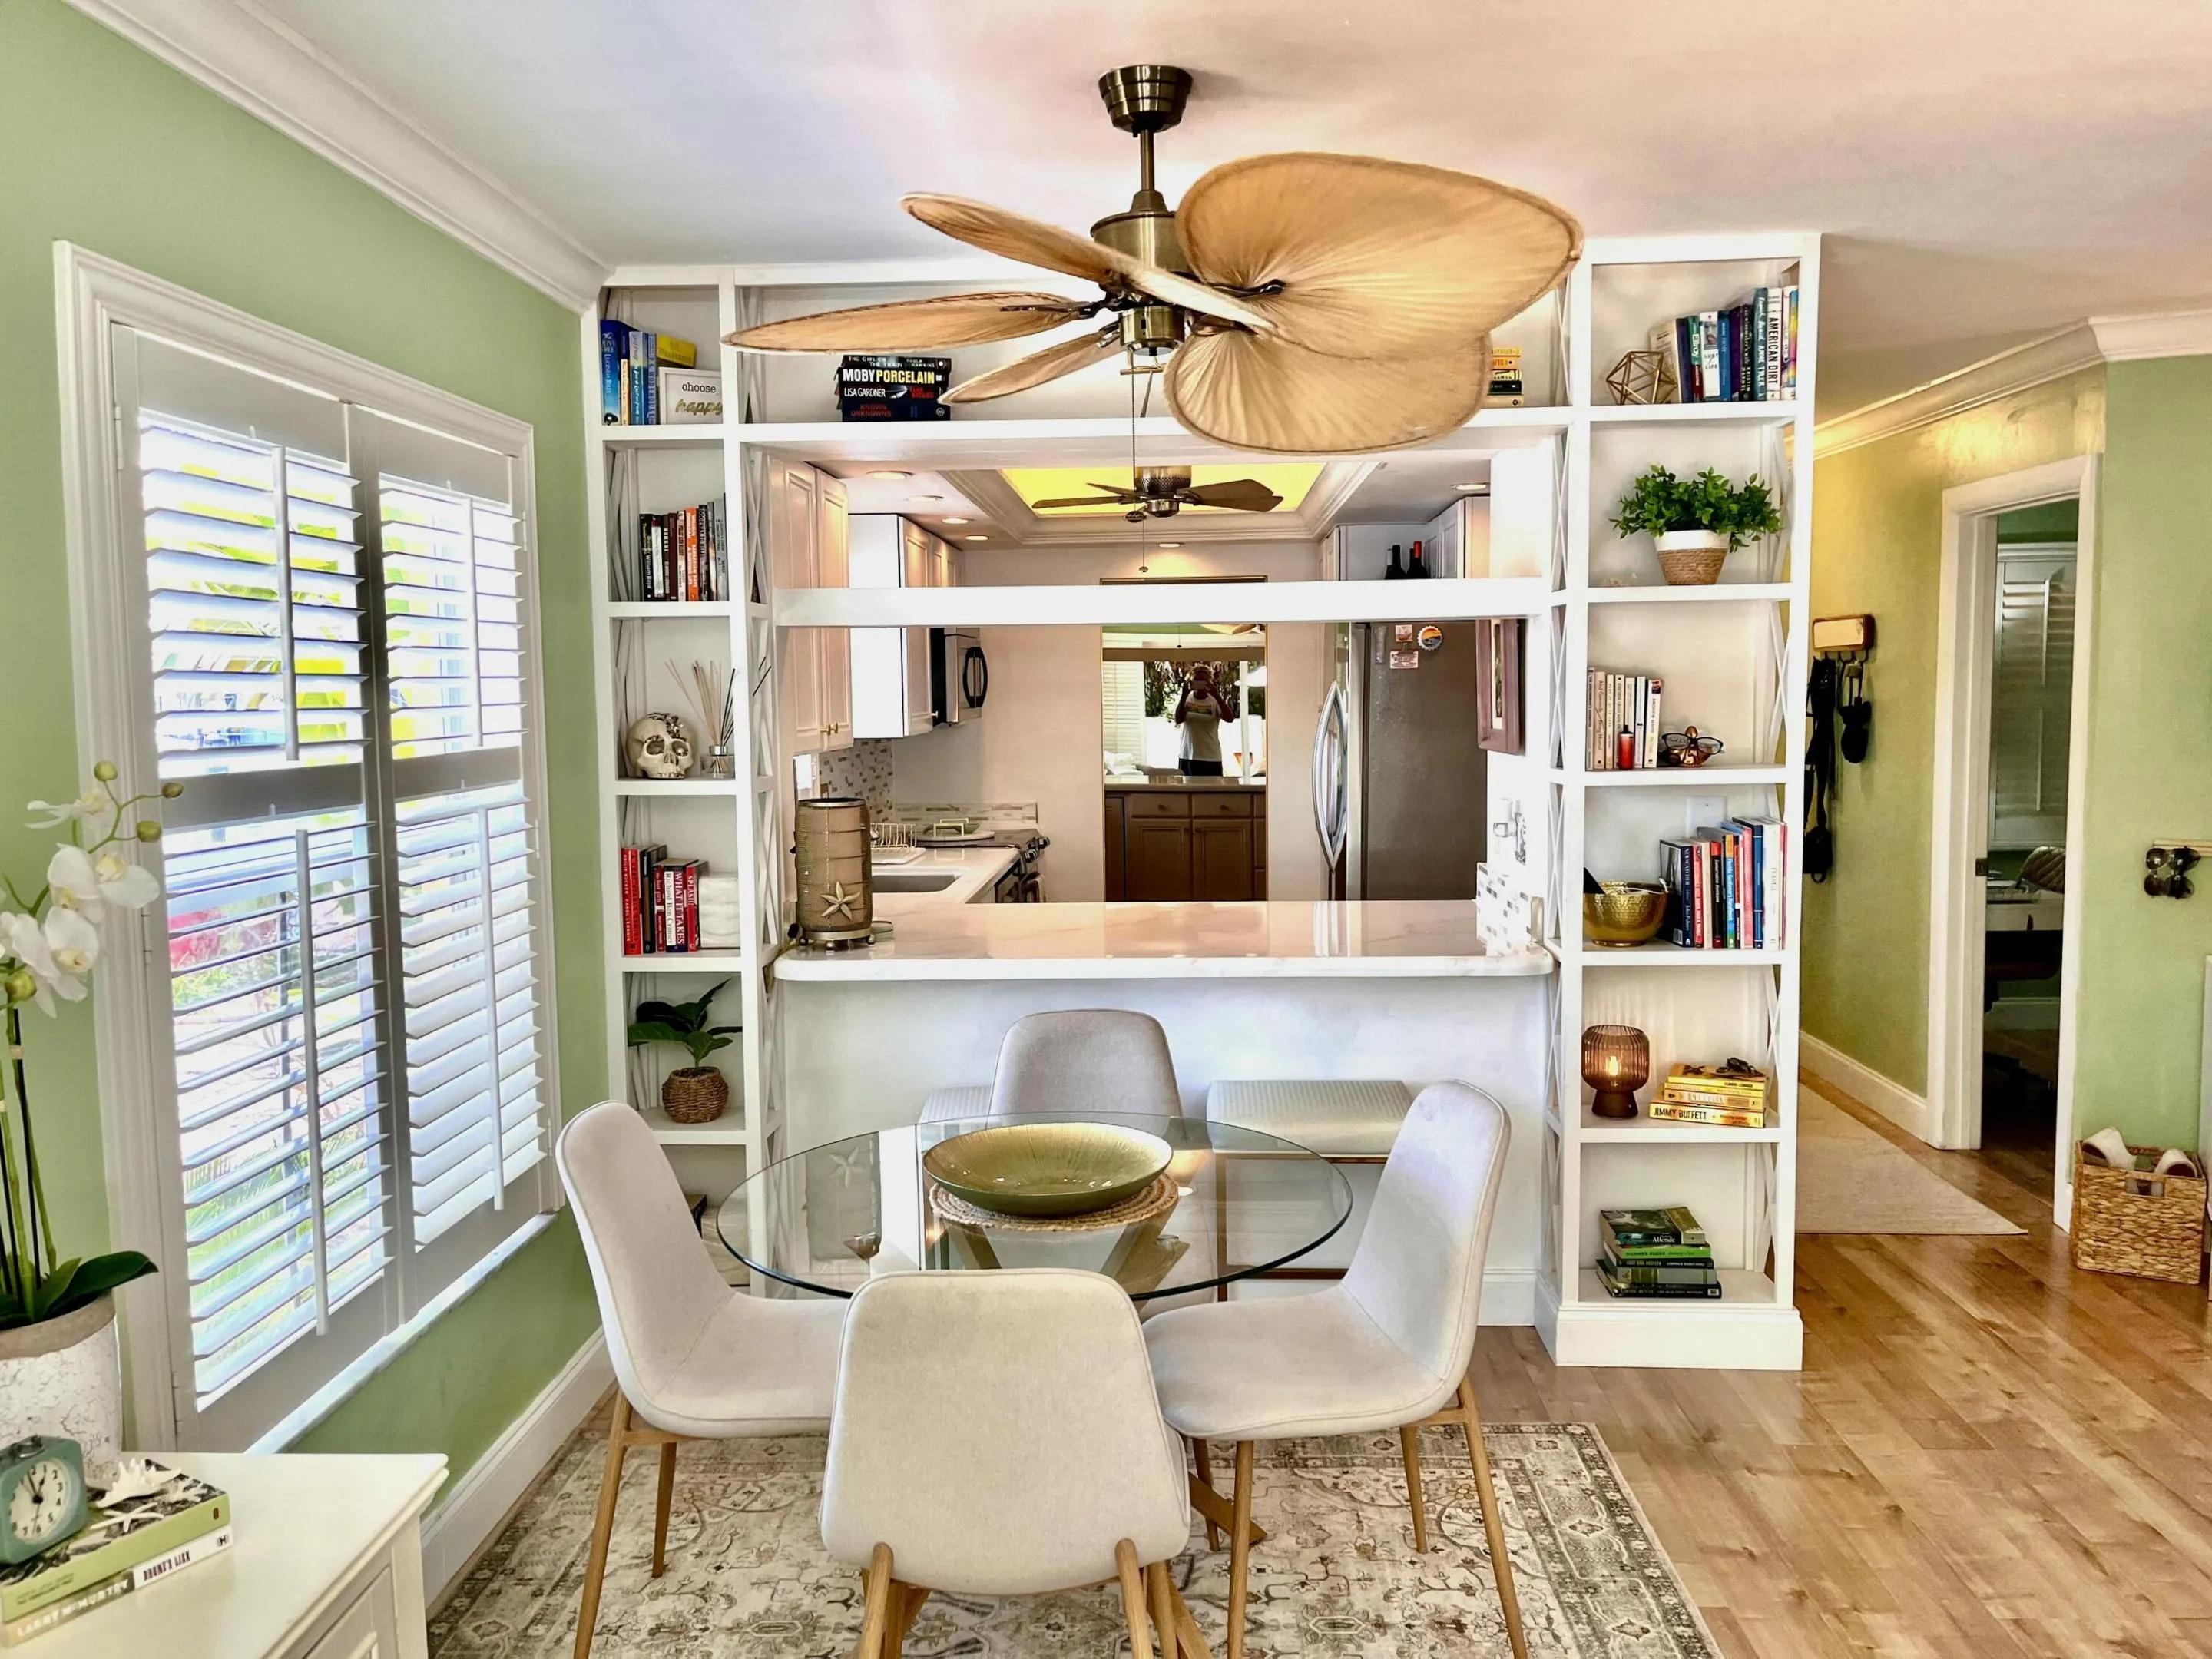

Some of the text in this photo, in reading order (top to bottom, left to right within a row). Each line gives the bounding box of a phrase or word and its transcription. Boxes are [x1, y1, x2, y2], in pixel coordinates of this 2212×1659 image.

[1691, 333, 1700, 358] Ellroy
[1768, 317, 1779, 362] AMERICAN
[843, 368, 935, 384] MOBY PORCELAIN
[1768, 365, 1779, 385] DIRT
[682, 382, 717, 393] choose
[844, 387, 886, 398] LISA GARDNER
[675, 399, 723, 416] happy
[665, 872, 674, 900] Richard
[674, 872, 685, 945] WHAT IT TAKES
[1654, 1107, 1677, 1118] JIMMY
[1678, 1109, 1707, 1121] BUFFETT
[51, 1469, 58, 1479] 2
[58, 1482, 63, 1492] 3
[55, 1498, 61, 1507] 4
[174, 1551, 191, 1568] LICK
